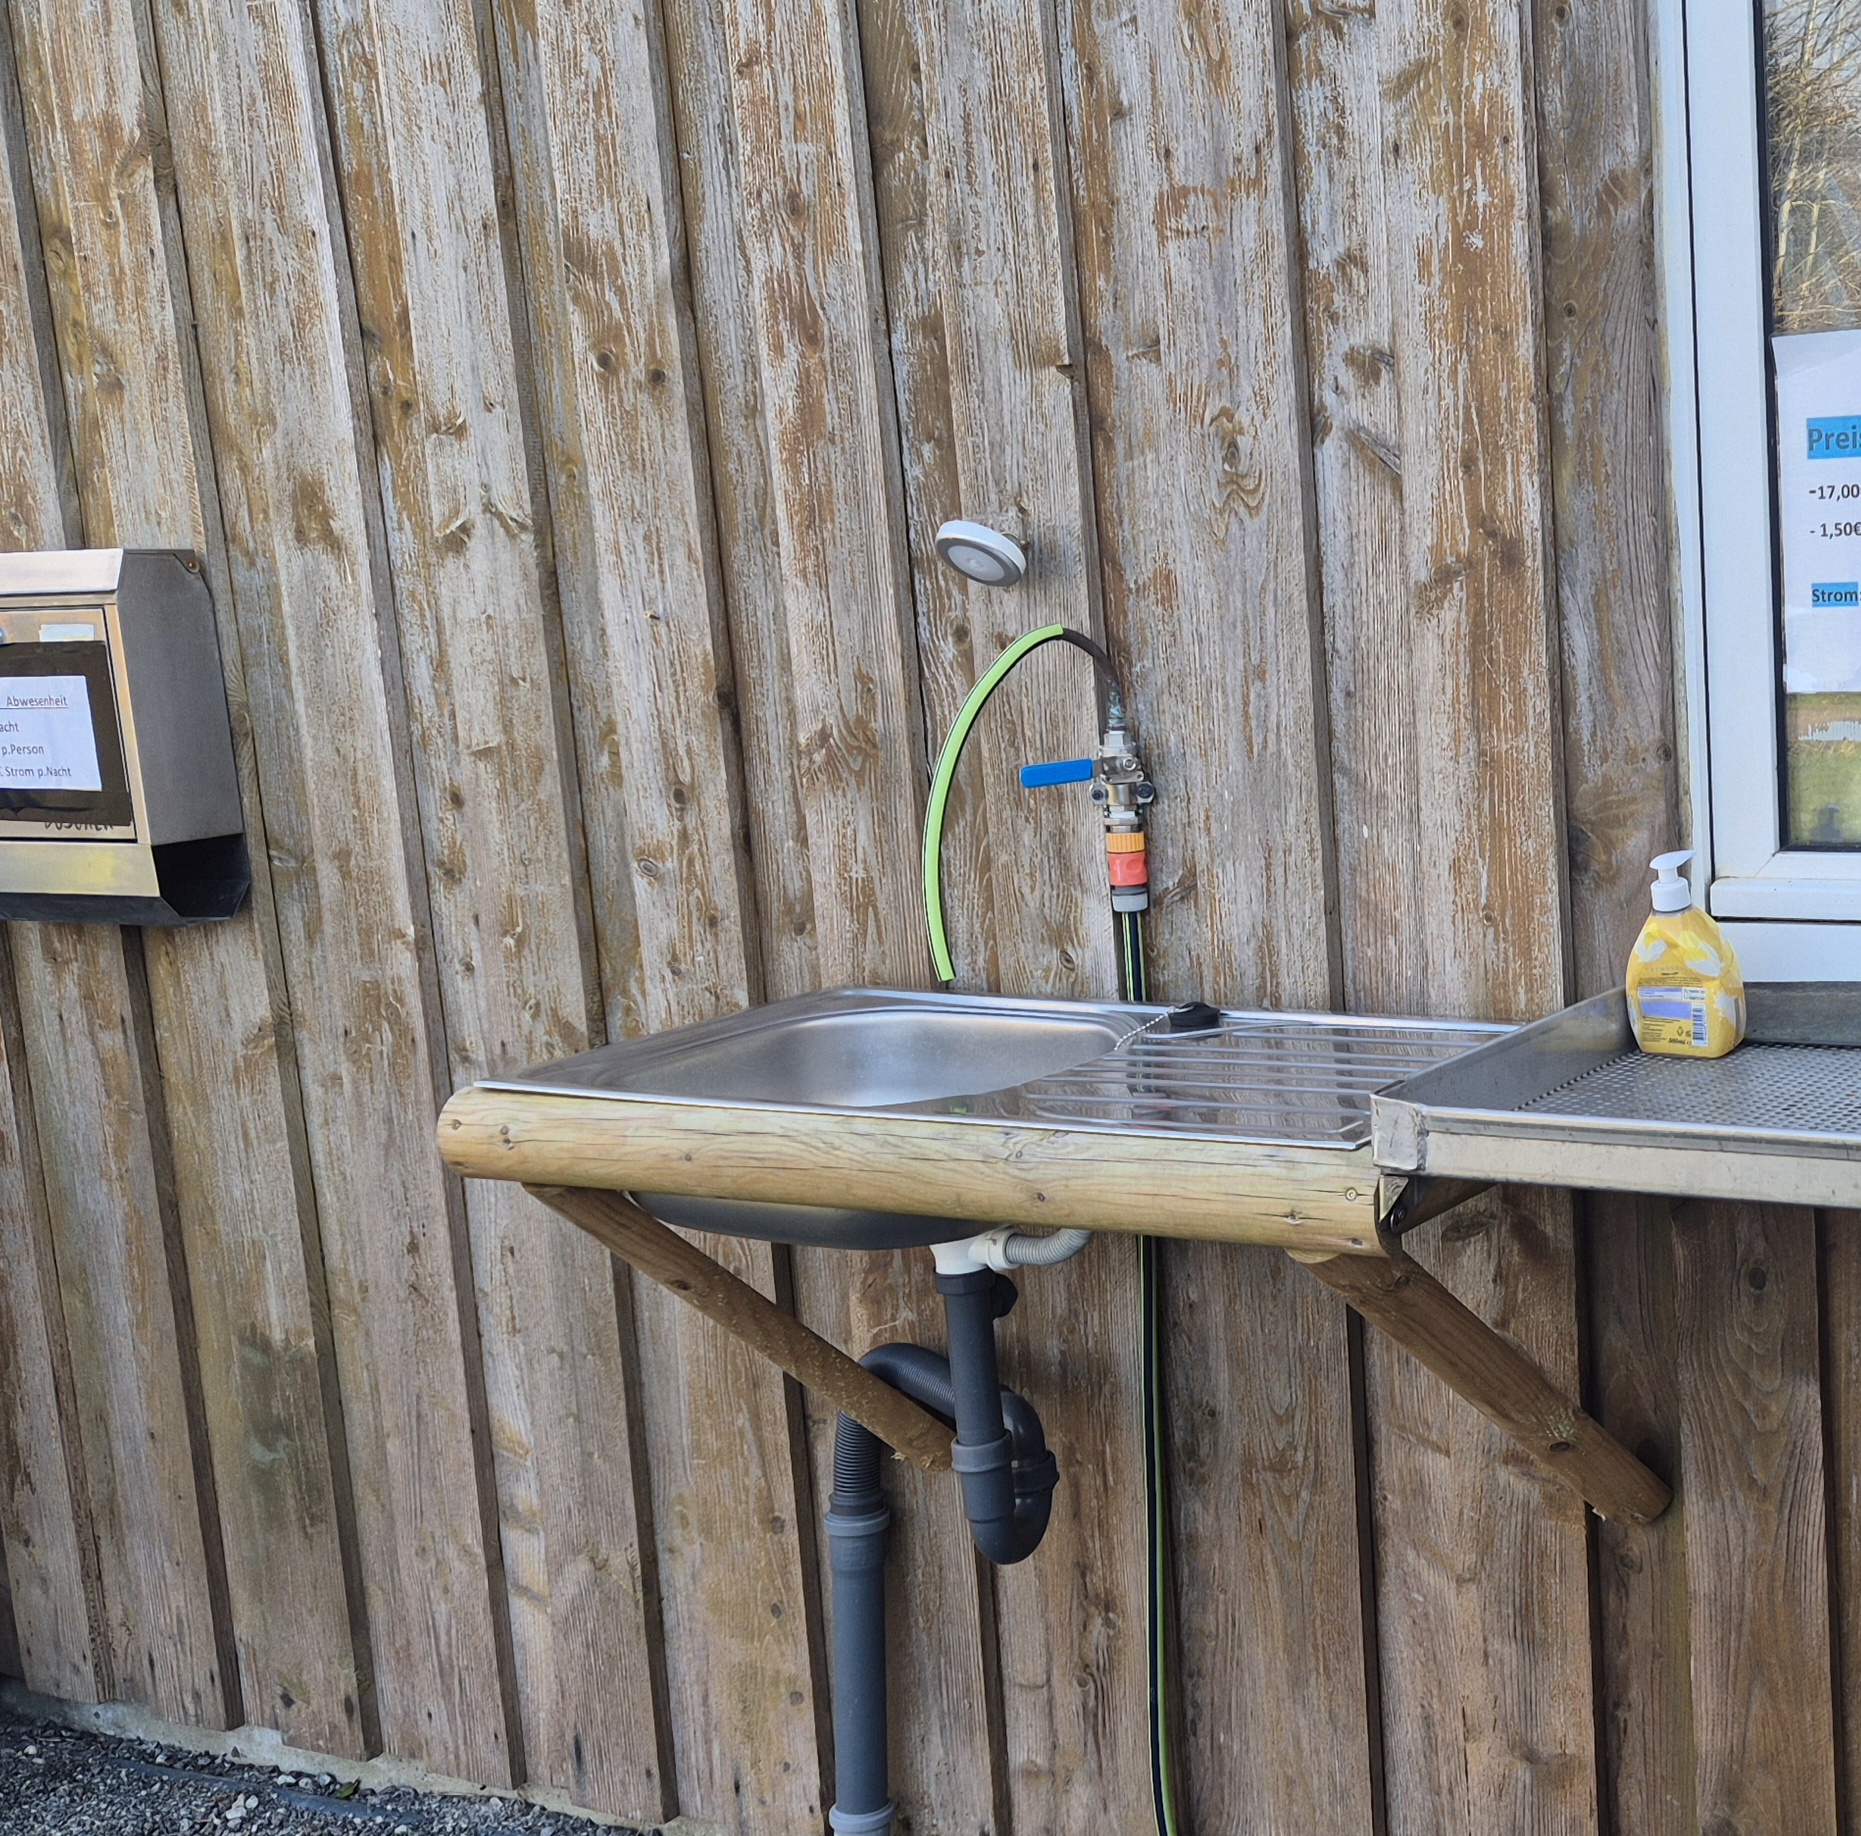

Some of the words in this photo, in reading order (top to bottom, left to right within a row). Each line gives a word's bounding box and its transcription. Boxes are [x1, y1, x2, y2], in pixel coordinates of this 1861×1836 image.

[6, 696, 68, 707] Abwesenheit
[2, 743, 44, 757] p.Person
[5, 766, 35, 777] Strom
[37, 765, 72, 779] p.Nacht
